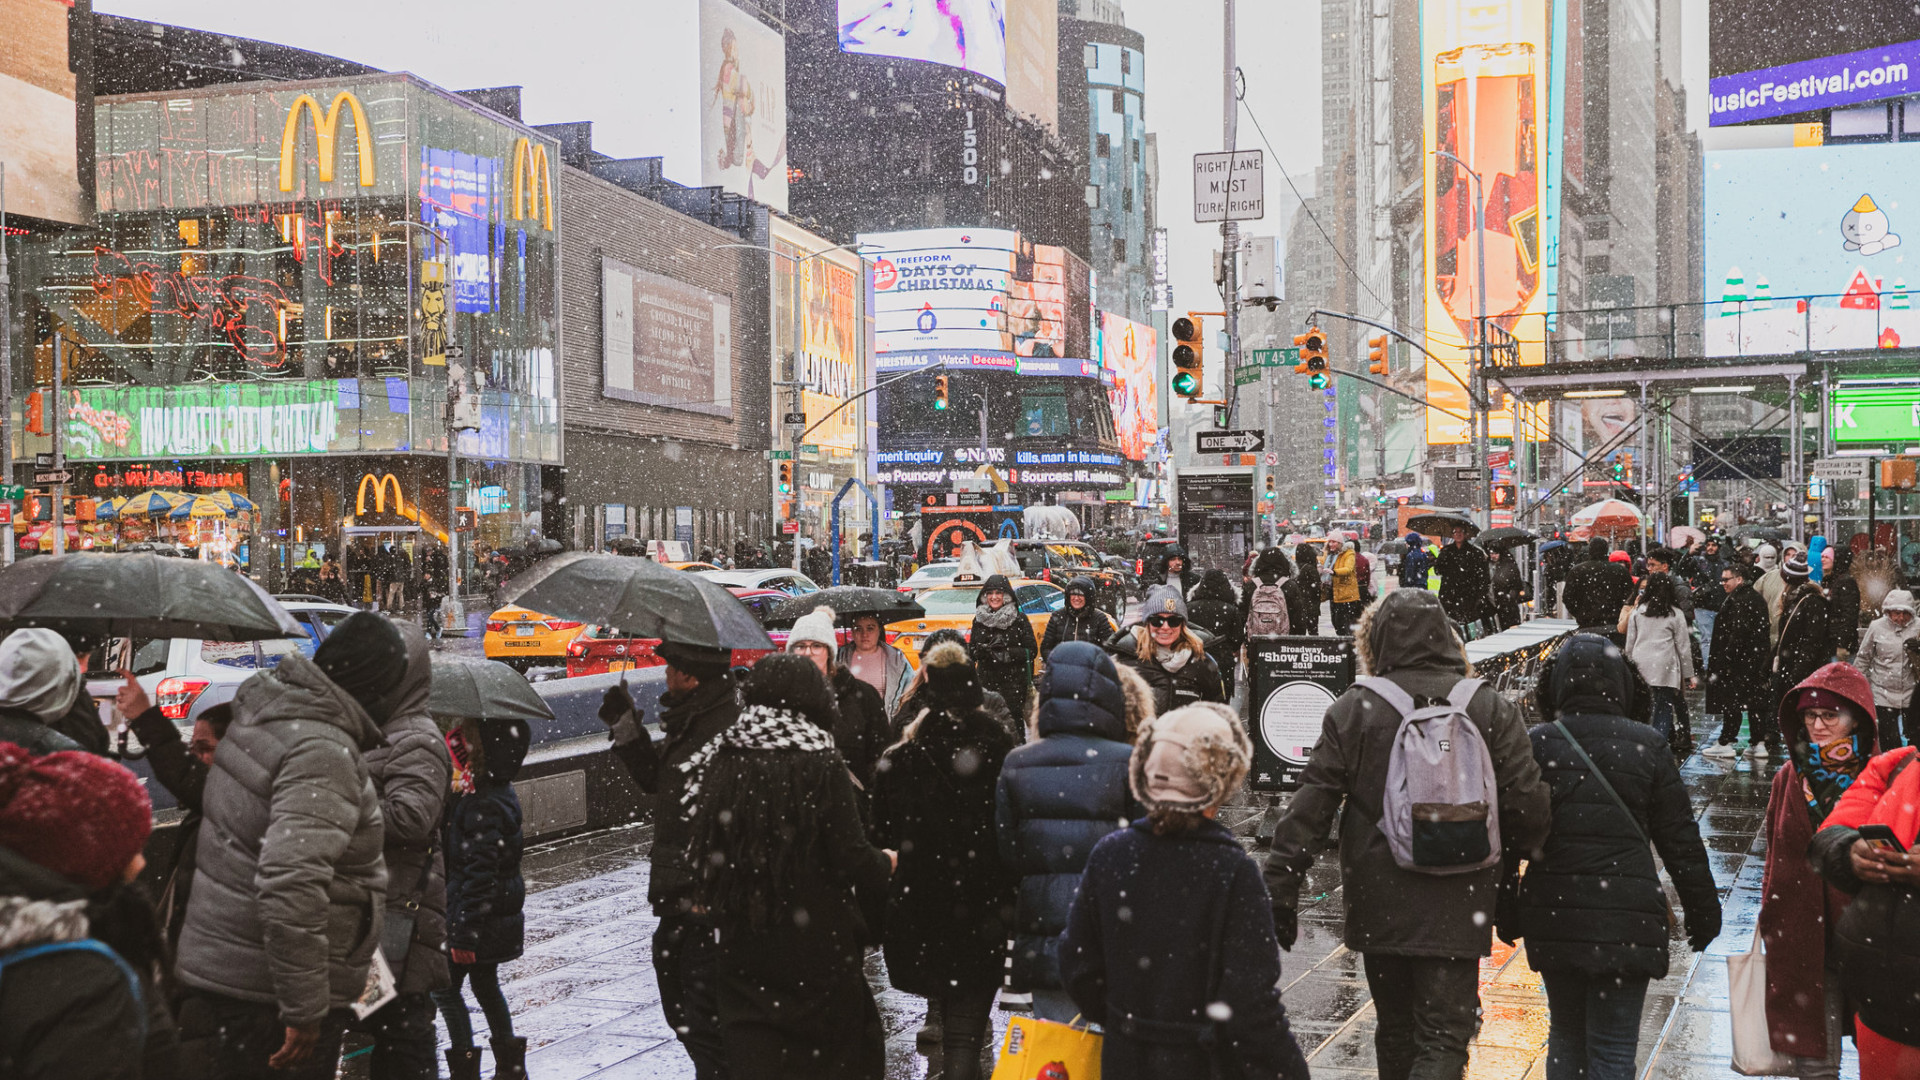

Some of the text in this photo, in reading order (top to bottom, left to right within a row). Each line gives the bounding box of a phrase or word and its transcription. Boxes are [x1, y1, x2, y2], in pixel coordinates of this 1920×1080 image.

[963, 110, 978, 184] 1500
[1196, 159, 1260, 173] RIGHT LANE
[1210, 179, 1247, 194] MUST
[1197, 200, 1261, 214] TURN RIGHT
[896, 254, 952, 264] FREEFORM
[901, 263, 978, 279] DAYS OF
[897, 278, 994, 293] CHRISTMAS
[939, 354, 970, 365] Watch
[1255, 352, 1266, 365] W
[1271, 351, 1286, 364] 45
[821, 356, 852, 399] NAVY
[1206, 436, 1255, 447] ONE WAY
[904, 449, 943, 464] inquiry
[1041, 453, 1065, 463] man
[1067, 451, 1077, 463] in
[809, 472, 834, 489] OLD NAVY
[1021, 470, 1073, 482] Sources:
[1, 487, 10, 499] 7
[1280, 646, 1322, 654] Broadway
